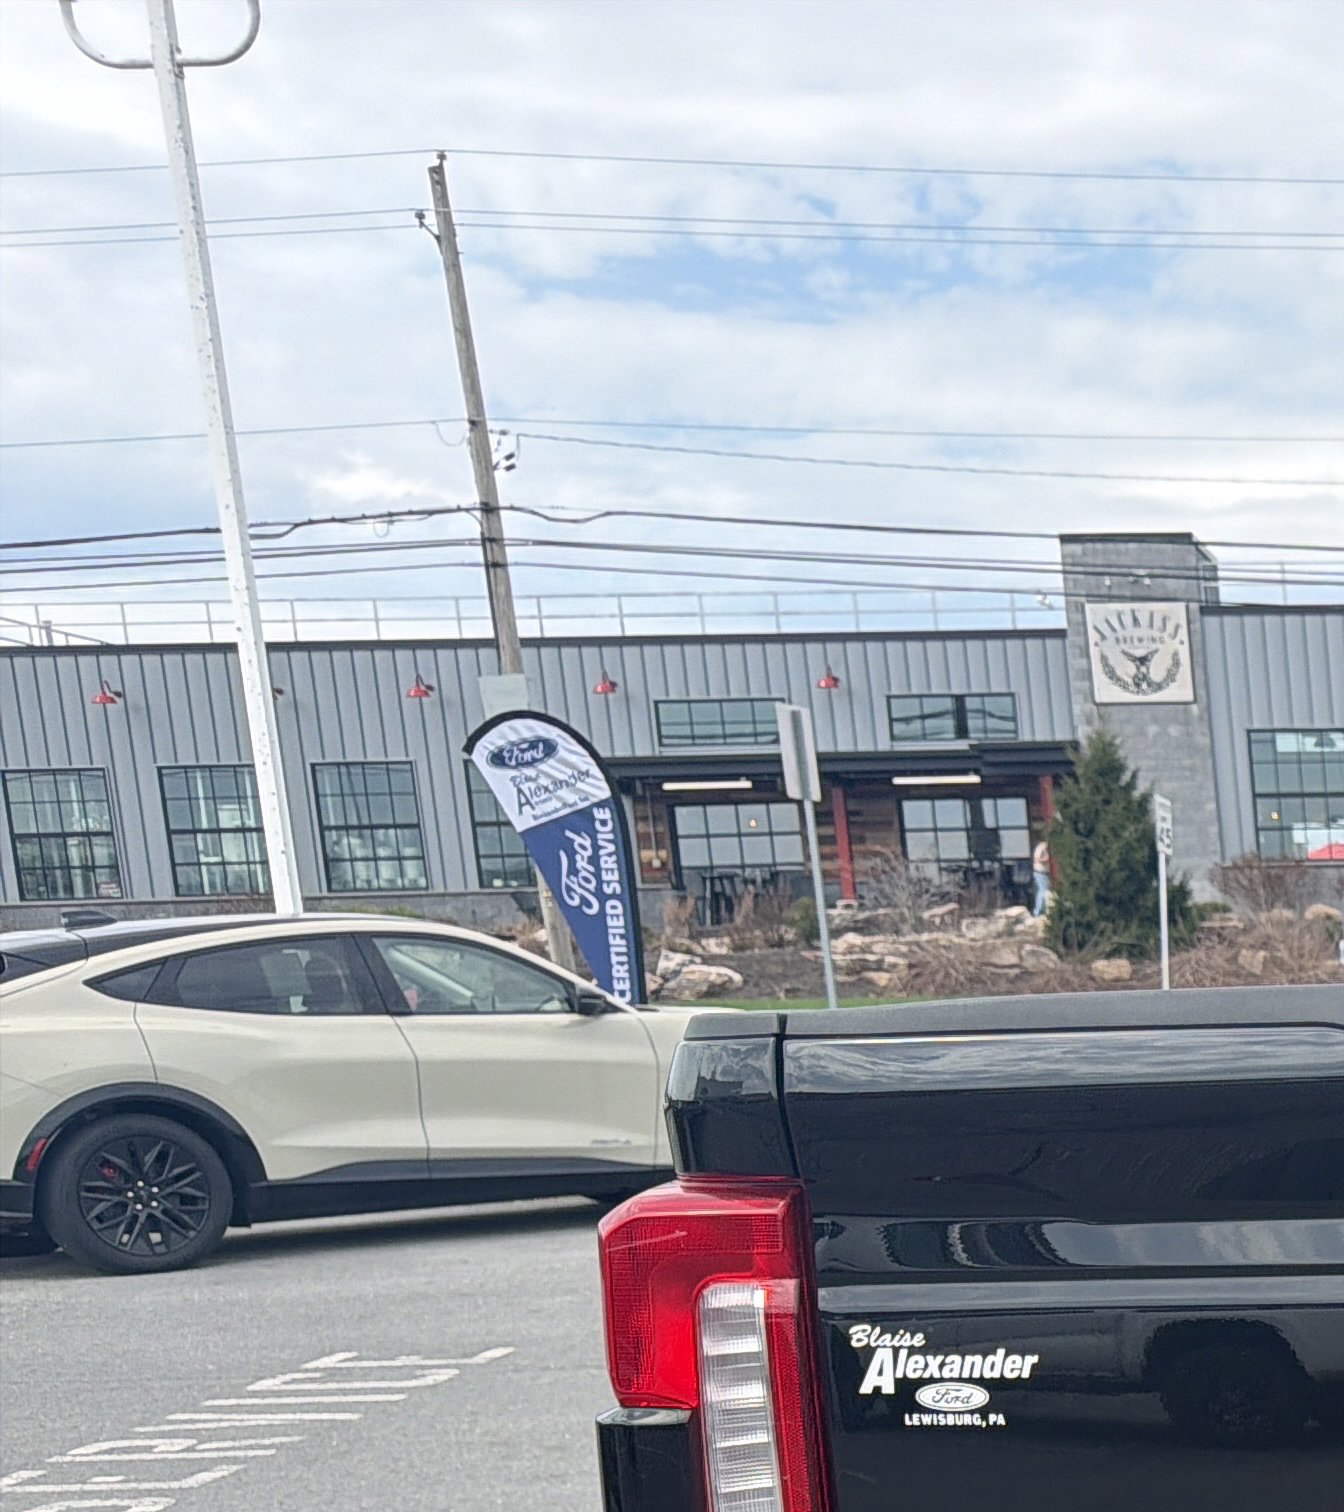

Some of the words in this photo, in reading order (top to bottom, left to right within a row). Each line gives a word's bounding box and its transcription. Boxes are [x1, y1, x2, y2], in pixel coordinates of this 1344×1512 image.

[503, 741, 545, 767] Ford
[516, 769, 591, 816] Alexander
[559, 829, 600, 916] Ford
[594, 806, 621, 896] SERVICE
[605, 899, 631, 1005] CERTIFIED
[849, 1324, 926, 1348] Blaise
[859, 1347, 1039, 1395] Alexander
[931, 1387, 974, 1405] Ford
[904, 1413, 987, 1428] LEWISBURG,
[988, 1413, 1006, 1426] PA
